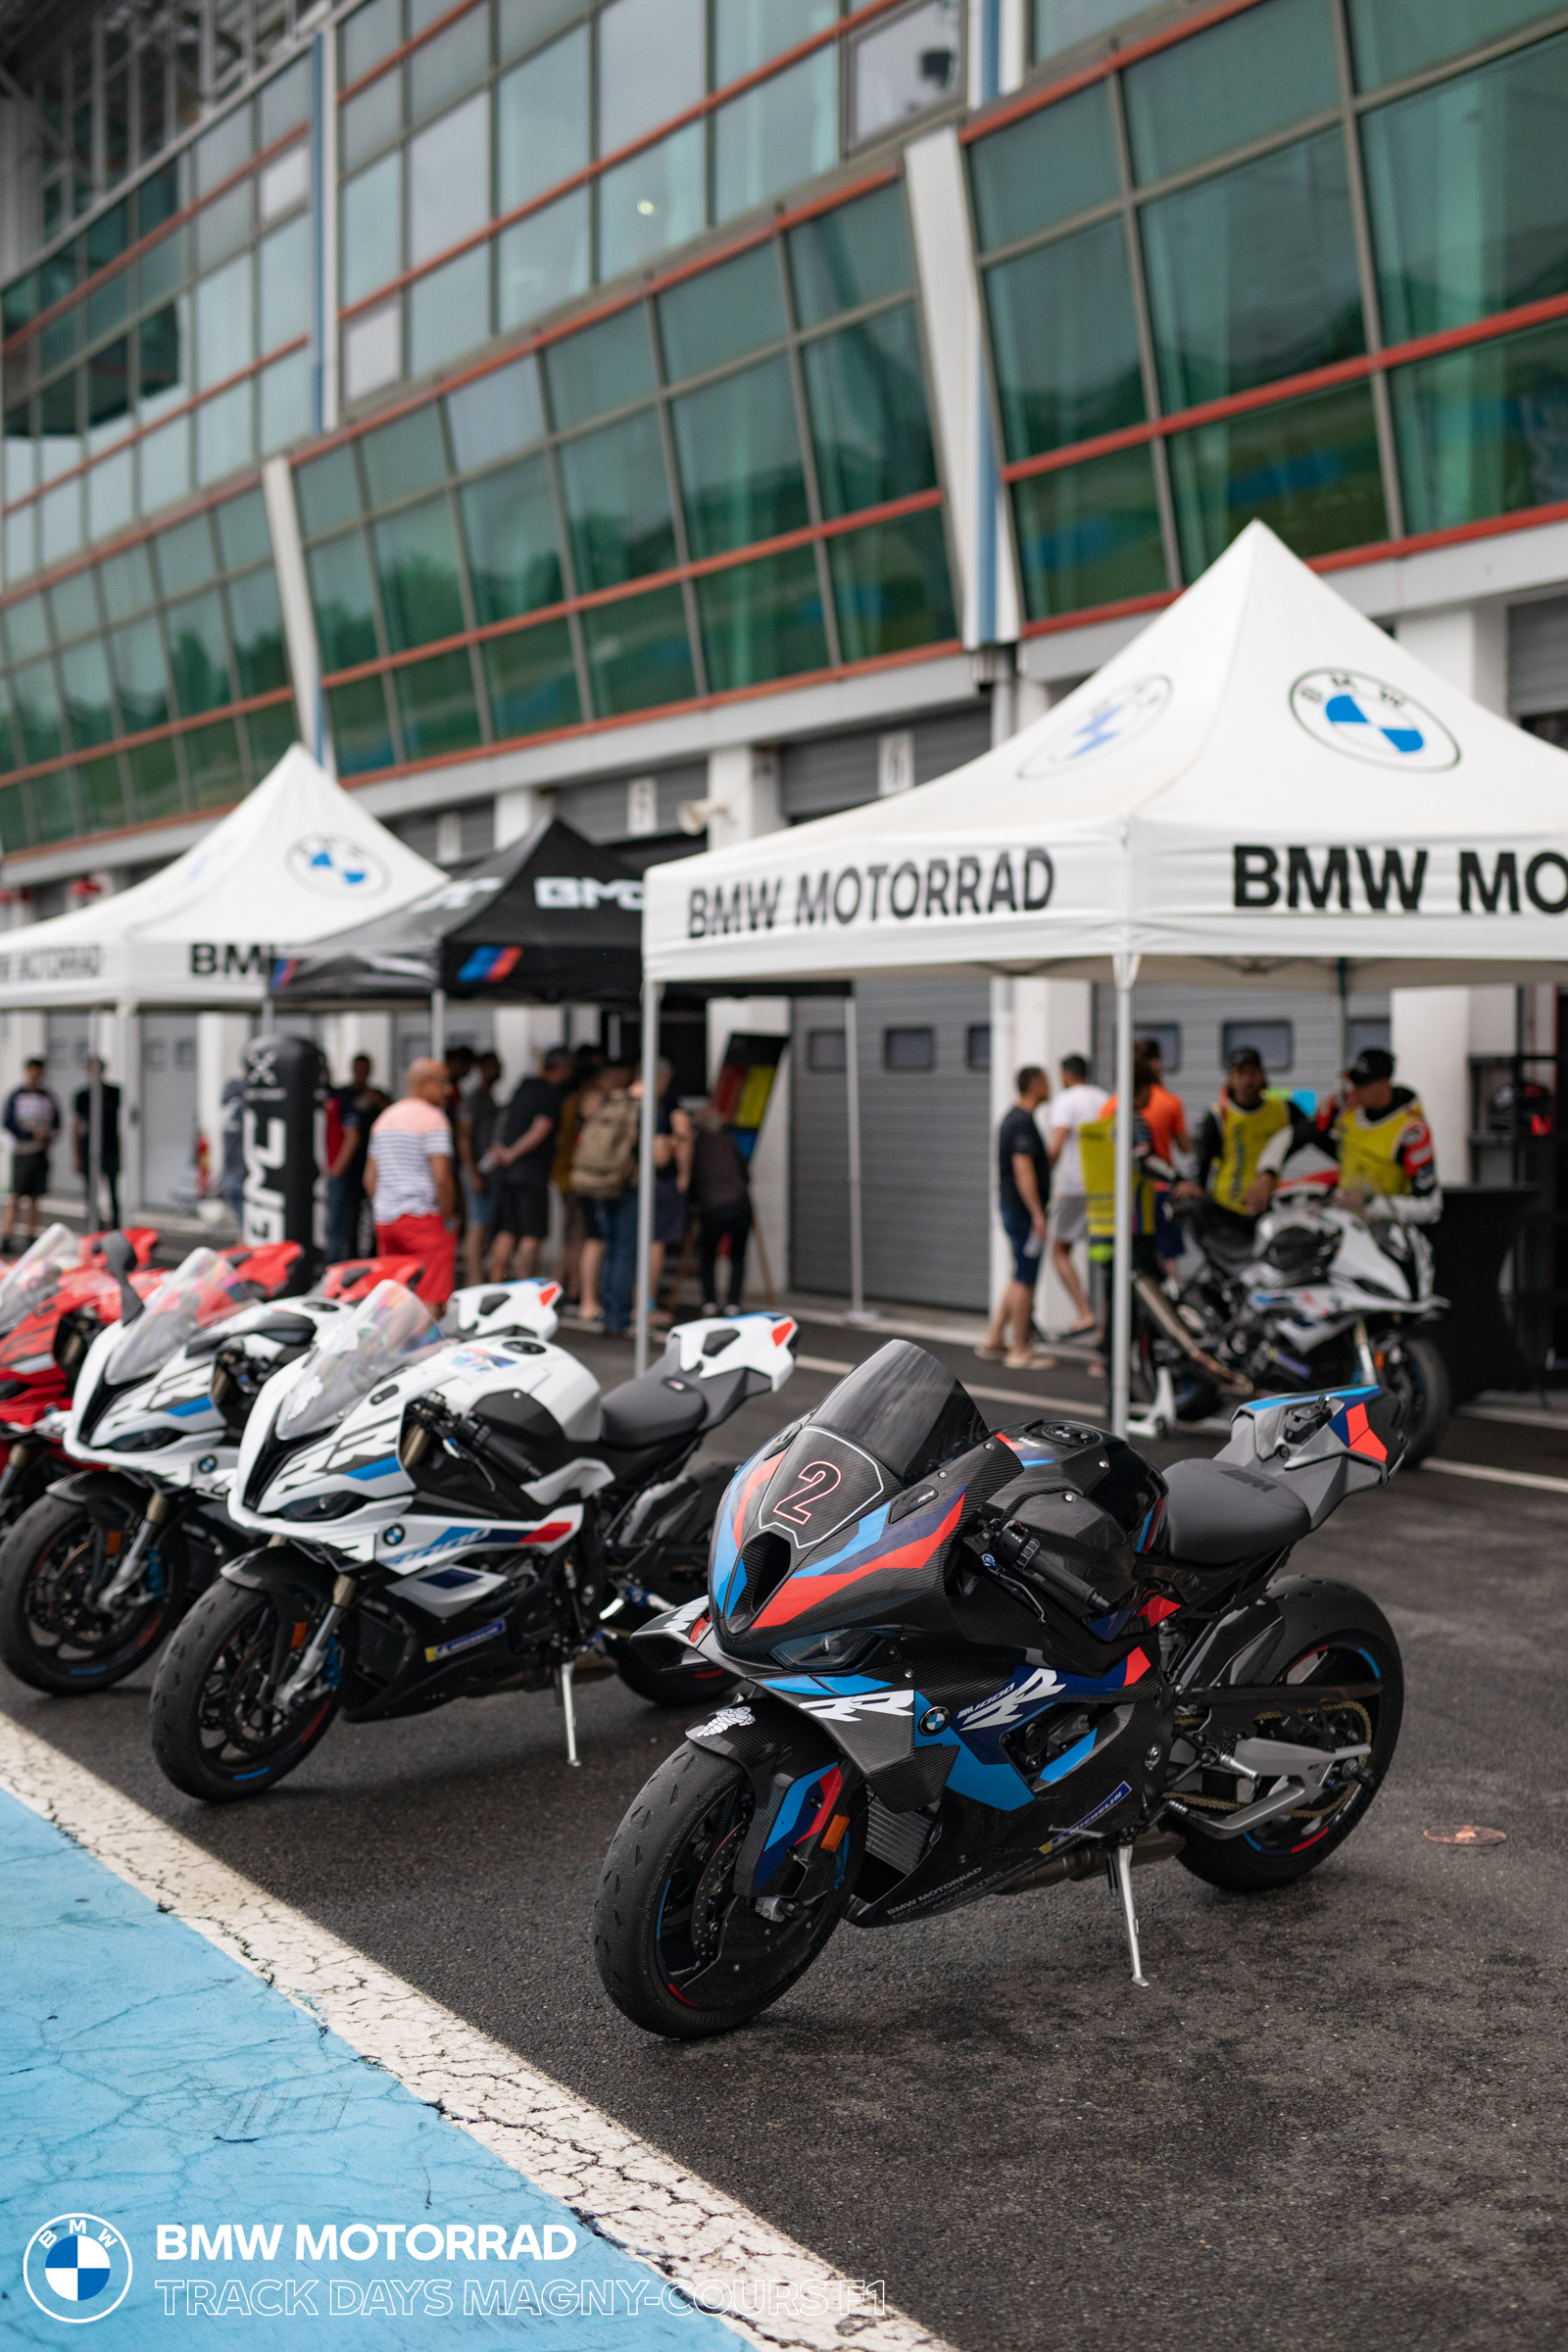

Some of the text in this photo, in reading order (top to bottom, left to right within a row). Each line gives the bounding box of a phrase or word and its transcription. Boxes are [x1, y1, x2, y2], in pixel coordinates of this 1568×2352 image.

[688, 847, 1055, 938] BMW MOTORRAD
[1233, 845, 1428, 911] BMW
[190, 943, 275, 975] BM
[772, 1460, 842, 1526] 2
[1068, 1790, 1122, 1837] MICHELIN
[886, 1866, 983, 1916] BMW MOTORRAD
[891, 1882, 965, 1921] MOTORSPORT
